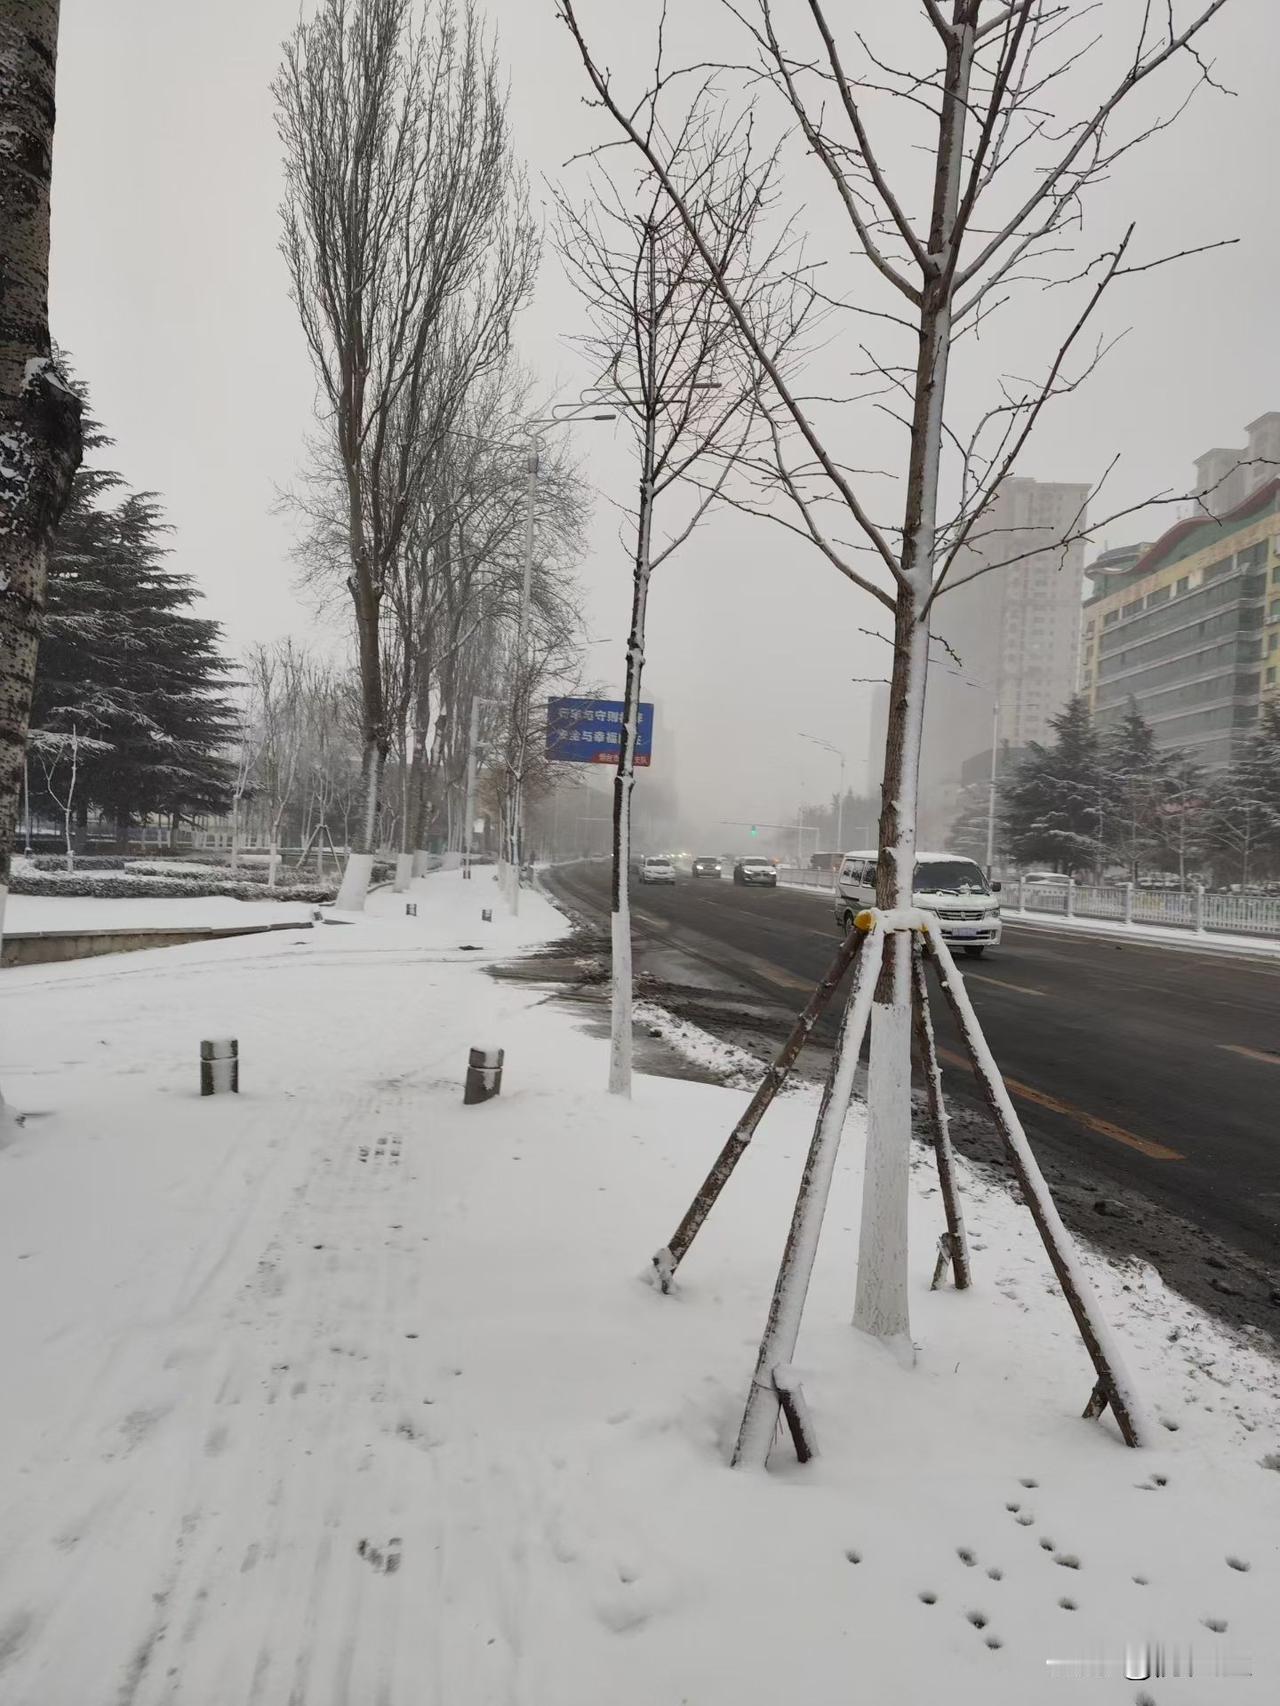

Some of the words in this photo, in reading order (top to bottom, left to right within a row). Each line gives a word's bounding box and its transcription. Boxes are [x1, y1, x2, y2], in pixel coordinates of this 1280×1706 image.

[559, 729, 642, 746] 安全与幸福
